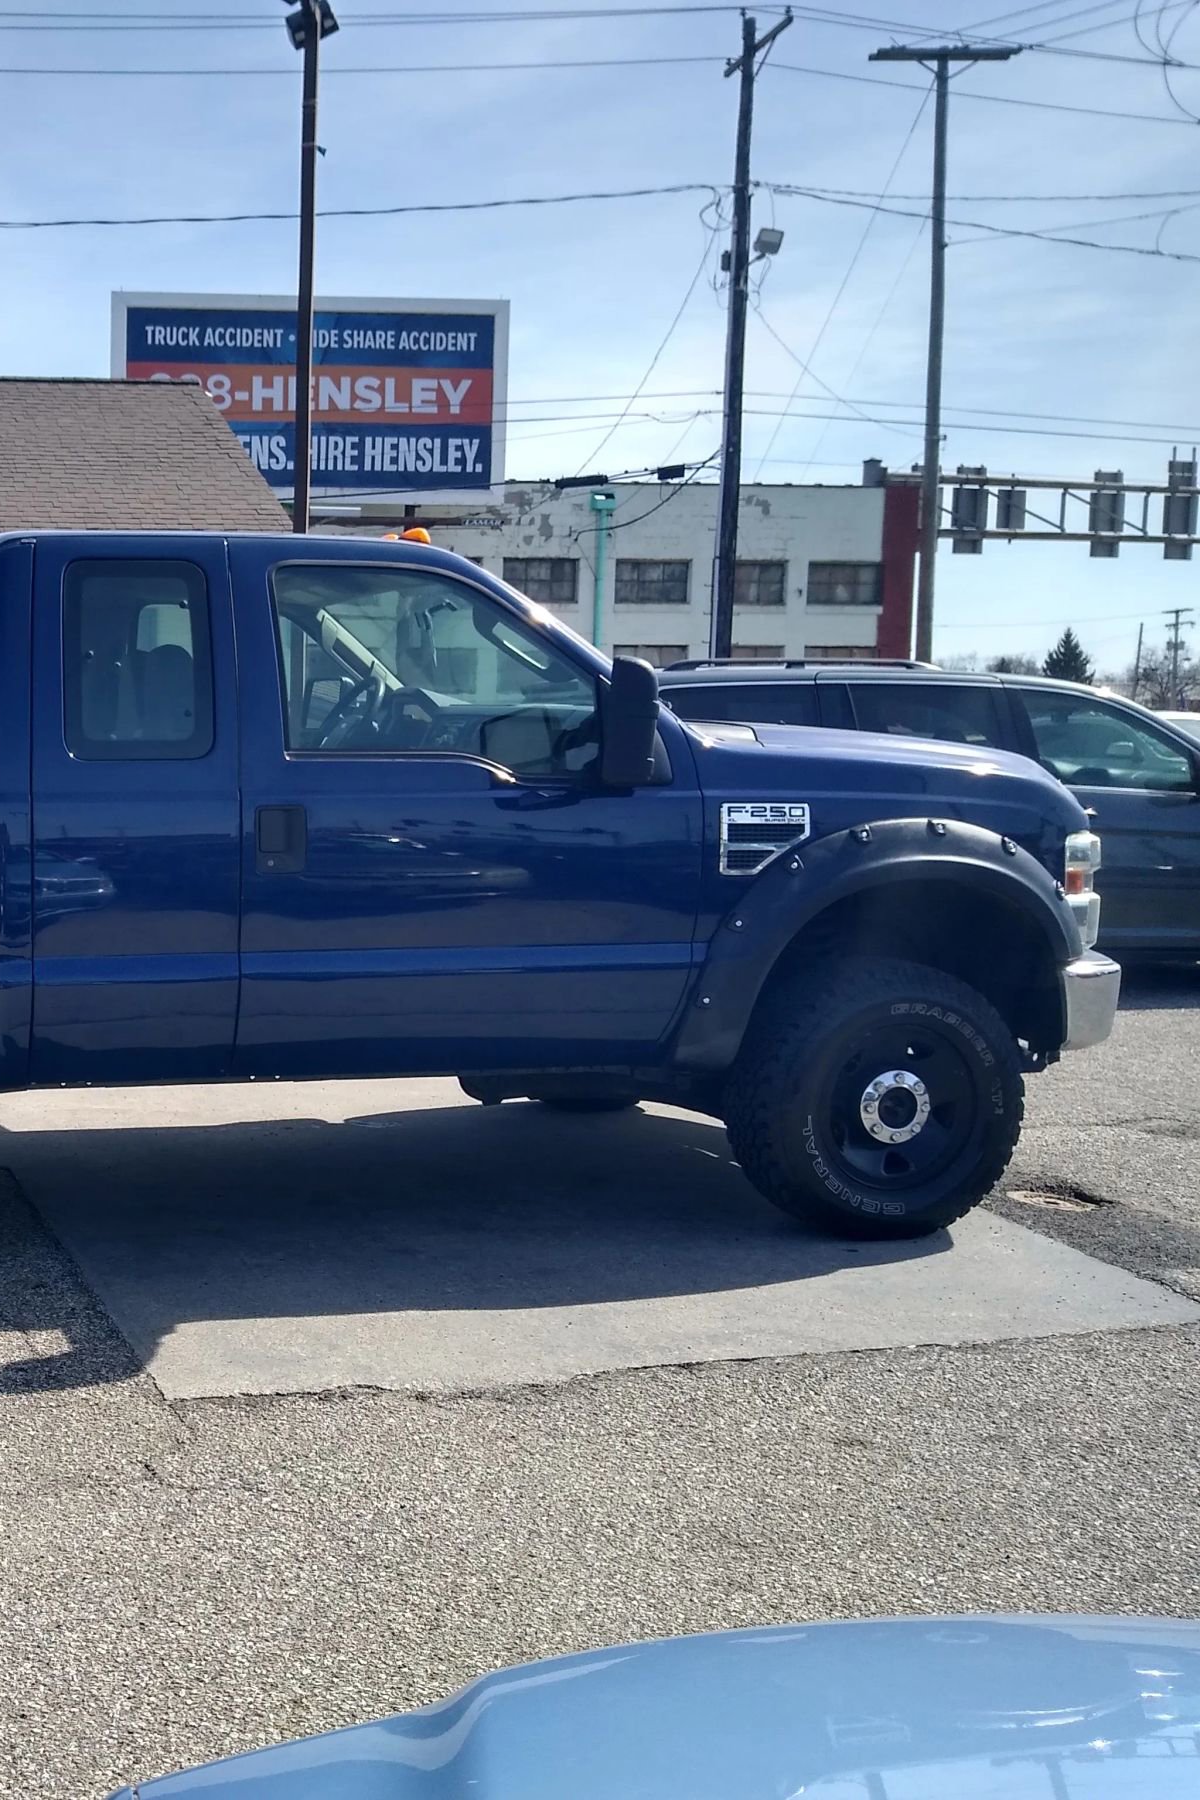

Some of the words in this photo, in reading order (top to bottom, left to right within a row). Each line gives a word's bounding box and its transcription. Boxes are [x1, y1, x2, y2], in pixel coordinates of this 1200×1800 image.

[145, 325, 200, 346] TRUCK
[204, 327, 284, 348] ACCIDENT
[312, 329, 339, 349] IDE
[343, 330, 396, 350] SHARE
[399, 331, 478, 352] ACCIDENT
[150, 372, 473, 415] 8-HENSLEY
[364, 437, 483, 473] HENSLEY.
[727, 806, 806, 818] F-250
